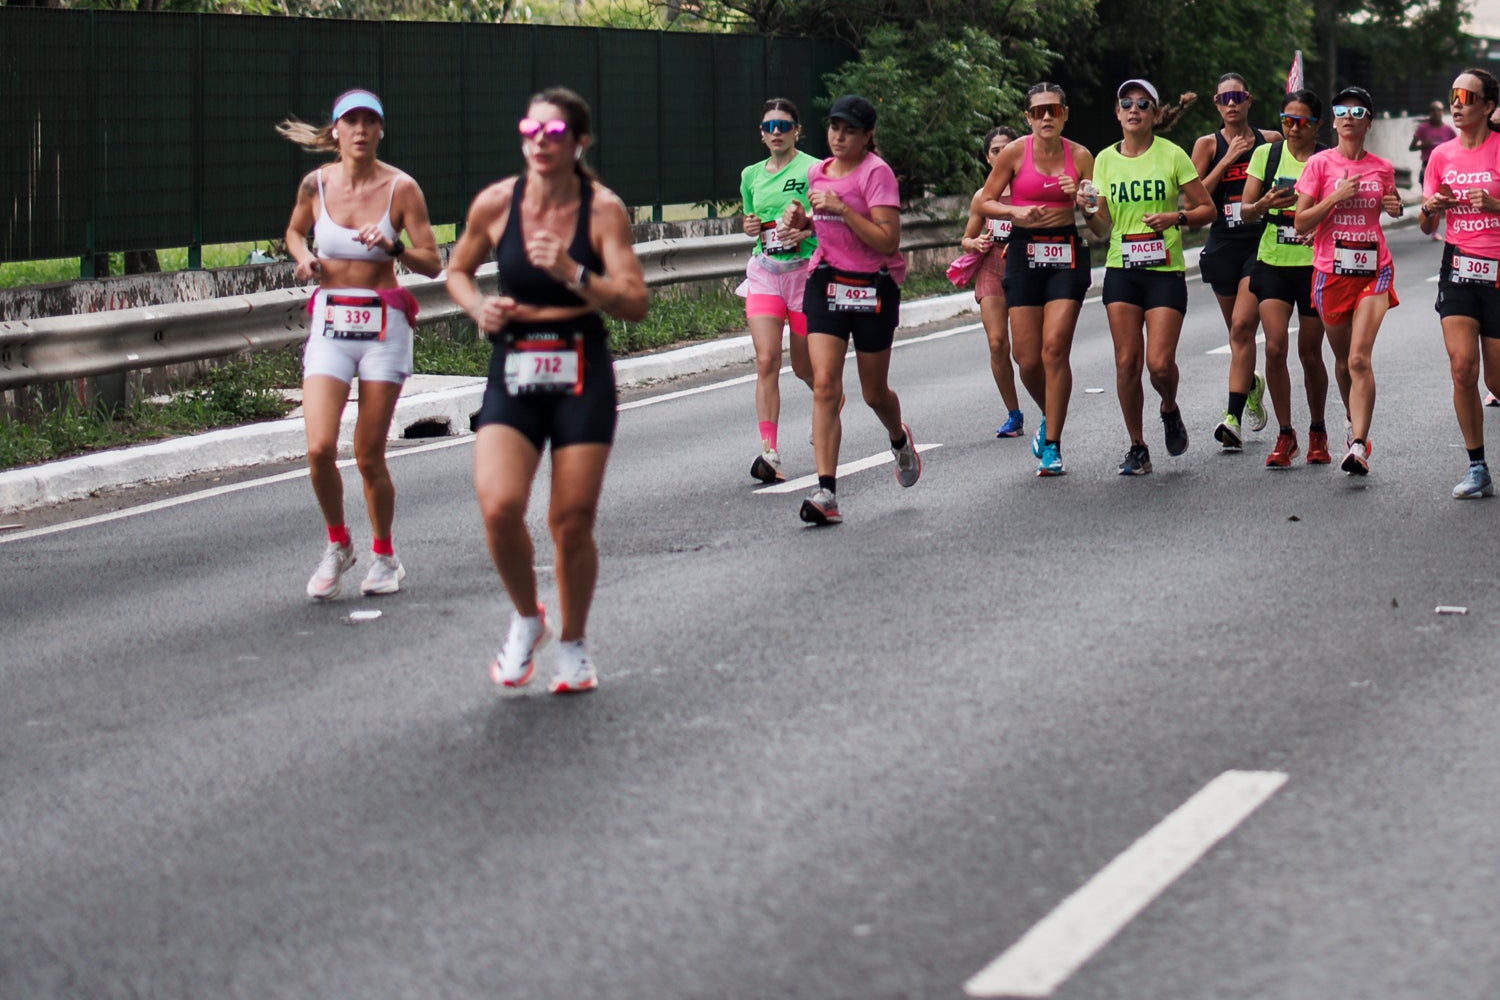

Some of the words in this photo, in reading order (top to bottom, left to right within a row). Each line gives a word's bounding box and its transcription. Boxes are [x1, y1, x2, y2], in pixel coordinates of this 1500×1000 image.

[1442, 169, 1493, 185] Corra
[782, 178, 806, 195] BR
[1110, 179, 1166, 204] PACER
[1334, 178, 1380, 192] Crra
[1334, 197, 1377, 209] como
[1333, 213, 1366, 225] uma
[1043, 245, 1063, 257] 301
[1131, 241, 1164, 253] PACER
[1353, 252, 1368, 264] 96
[1466, 260, 1490, 274] 305
[845, 288, 868, 299] 492
[345, 309, 371, 325] 339
[534, 356, 562, 374] 712
